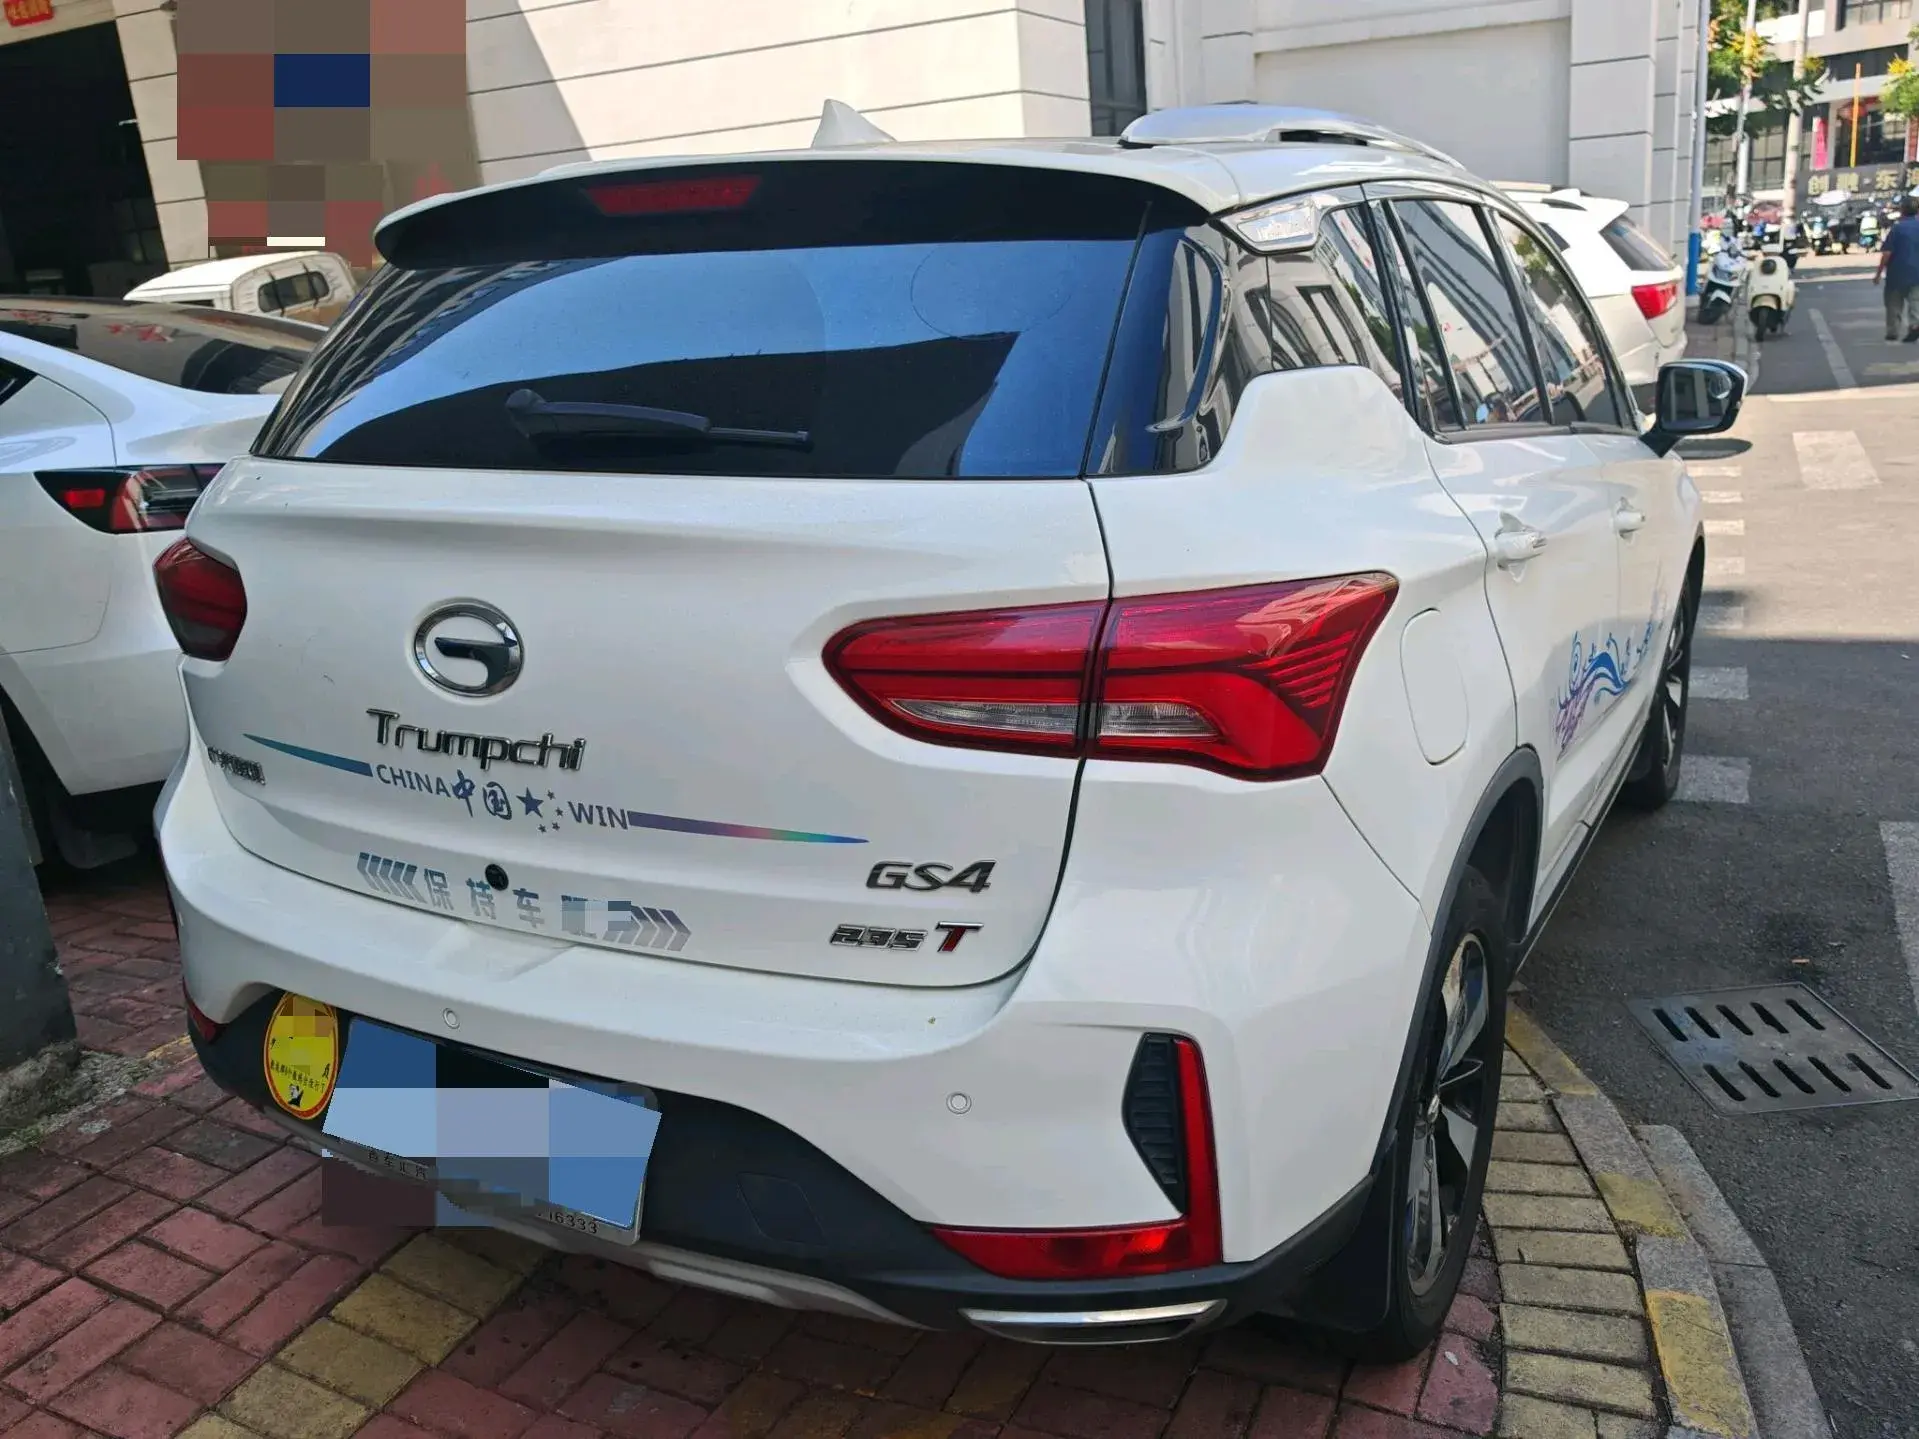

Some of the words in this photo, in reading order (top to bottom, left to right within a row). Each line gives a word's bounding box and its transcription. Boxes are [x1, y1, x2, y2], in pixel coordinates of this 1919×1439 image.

[366, 708, 586, 771] Trumpchi
[376, 763, 451, 798] CHINA
[567, 801, 628, 830] WIN
[423, 867, 597, 939] 保持车
[866, 857, 997, 893] GS4
[537, 1207, 599, 1235] 16333
